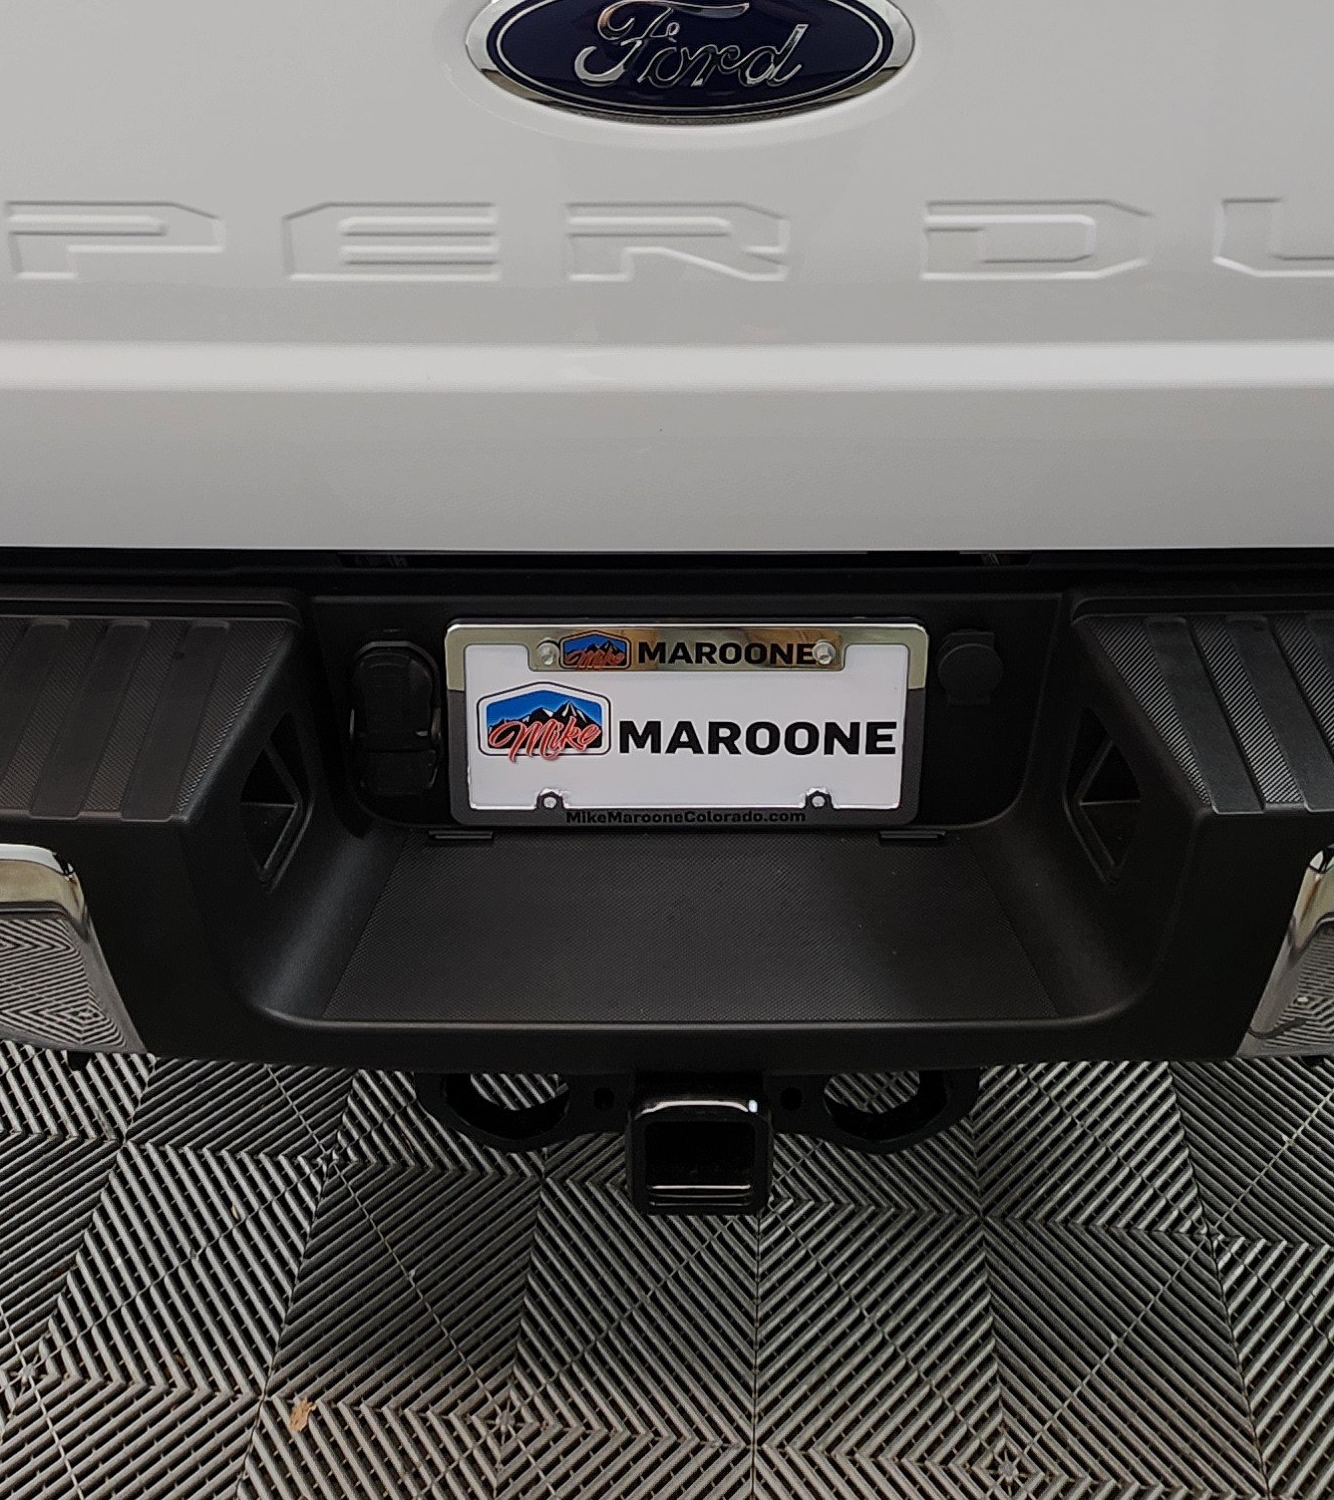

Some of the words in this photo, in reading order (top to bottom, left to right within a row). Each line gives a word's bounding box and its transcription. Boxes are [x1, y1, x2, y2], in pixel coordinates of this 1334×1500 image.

[566, 648, 627, 670] Mike
[638, 641, 818, 665] MAROONE
[489, 716, 601, 763] Mike
[619, 720, 897, 756] MAROONE
[566, 810, 806, 824] MikeMarooneColorado.com
